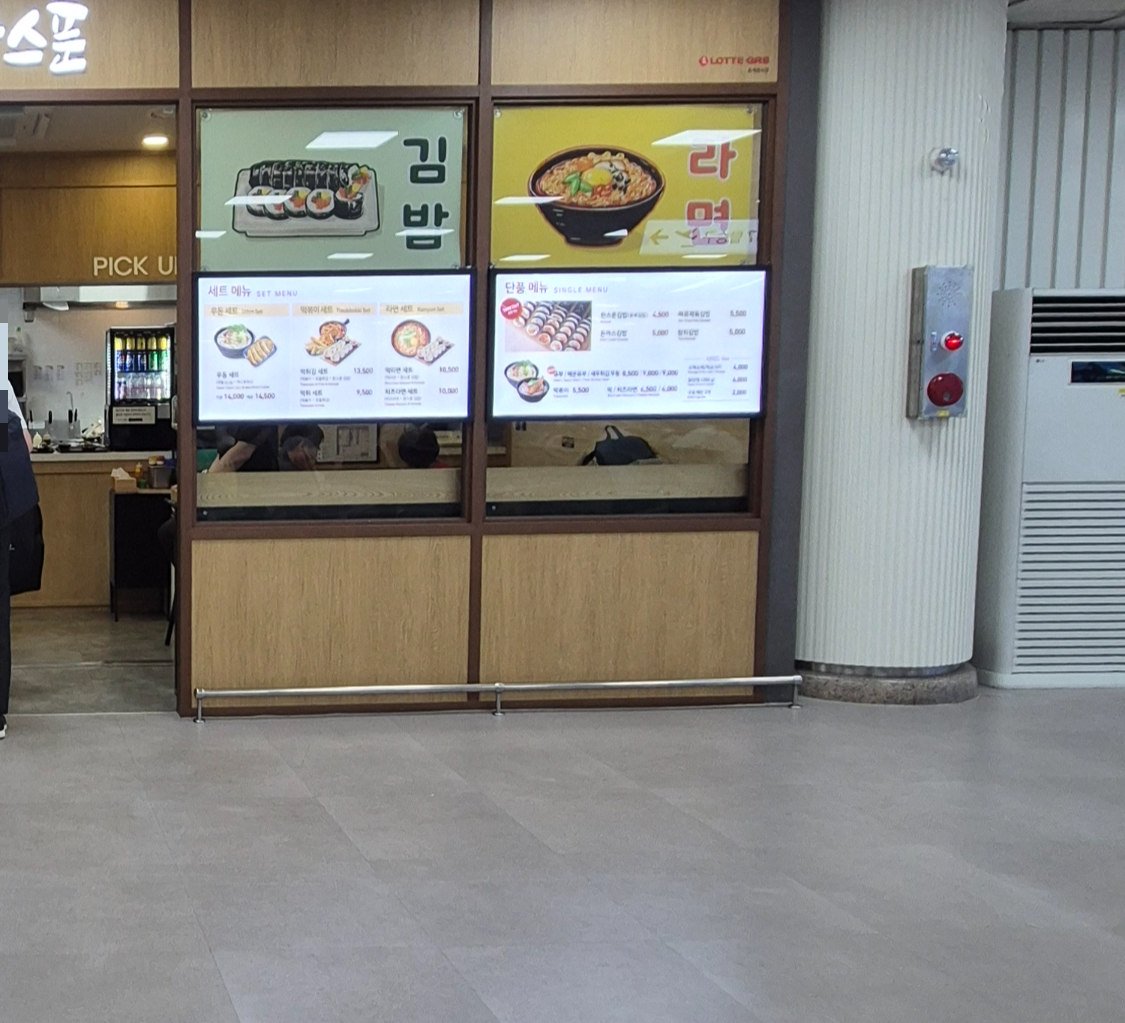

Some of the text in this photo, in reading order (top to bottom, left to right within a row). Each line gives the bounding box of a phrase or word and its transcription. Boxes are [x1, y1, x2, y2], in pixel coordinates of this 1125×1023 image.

[710, 57, 744, 65] LOTTE
[403, 136, 450, 250] 김밥
[687, 140, 737, 245] 라면
[93, 256, 177, 276] PICK U
[208, 284, 251, 297] 세트 메뉴
[528, 280, 548, 294] 메뉴
[554, 286, 582, 294] SINGLE
[320, 305, 333, 314] 세트
[386, 305, 413, 314] 라면 세트
